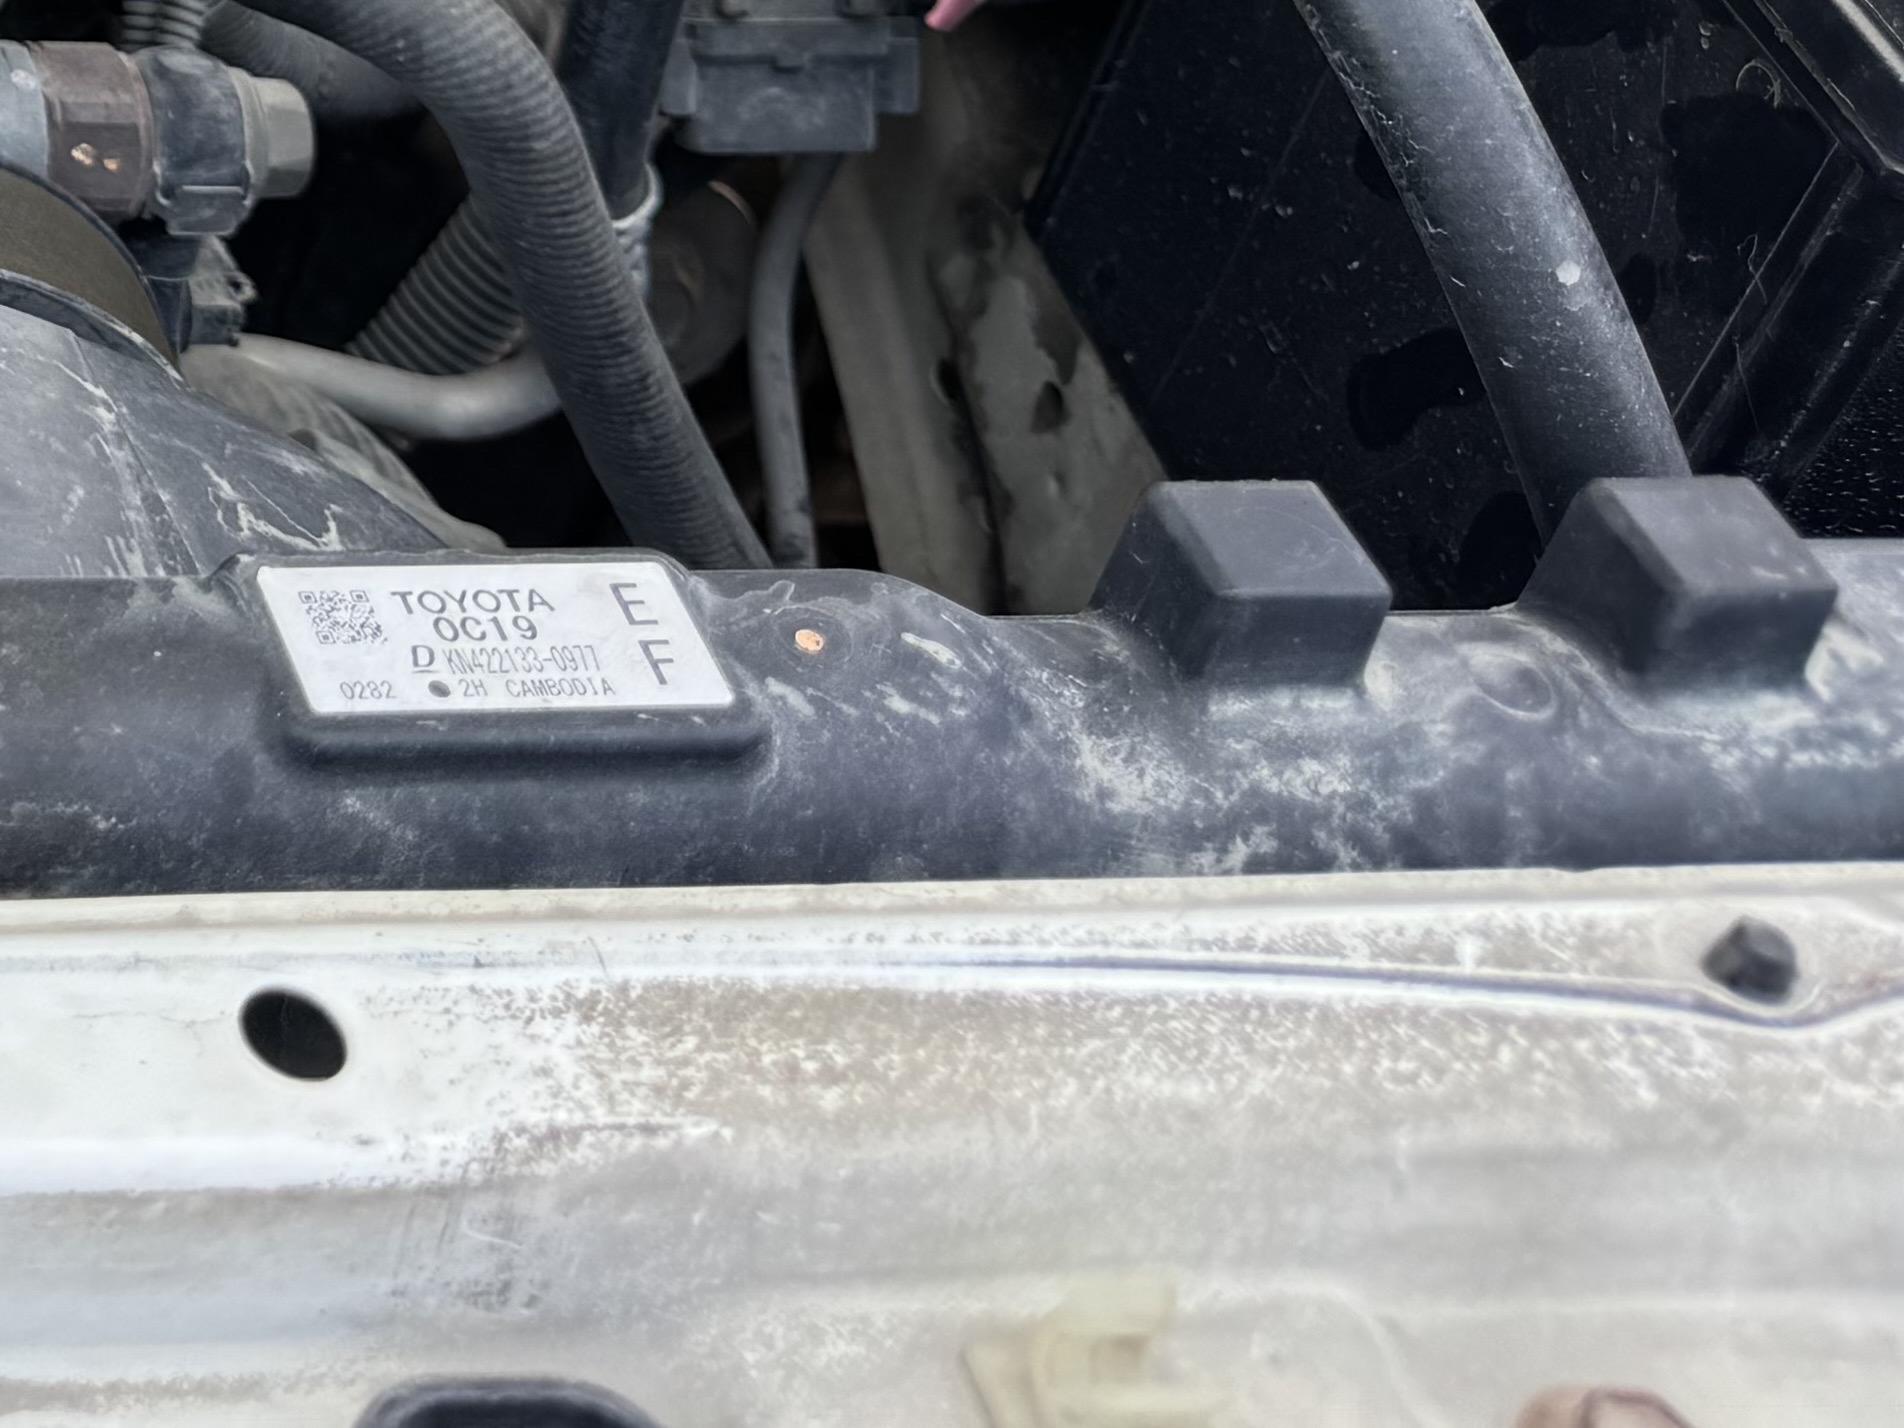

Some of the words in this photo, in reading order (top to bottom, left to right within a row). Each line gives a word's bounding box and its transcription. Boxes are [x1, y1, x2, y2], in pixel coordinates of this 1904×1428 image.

[390, 588, 557, 615] TOYOTA
[609, 582, 659, 627] E
[432, 616, 539, 643] 0C19
[444, 645, 601, 675] KN422133-0977
[637, 639, 675, 686] F
[338, 681, 398, 701] 0282
[462, 680, 490, 699] 2H
[505, 678, 617, 699] CAMBODIA
